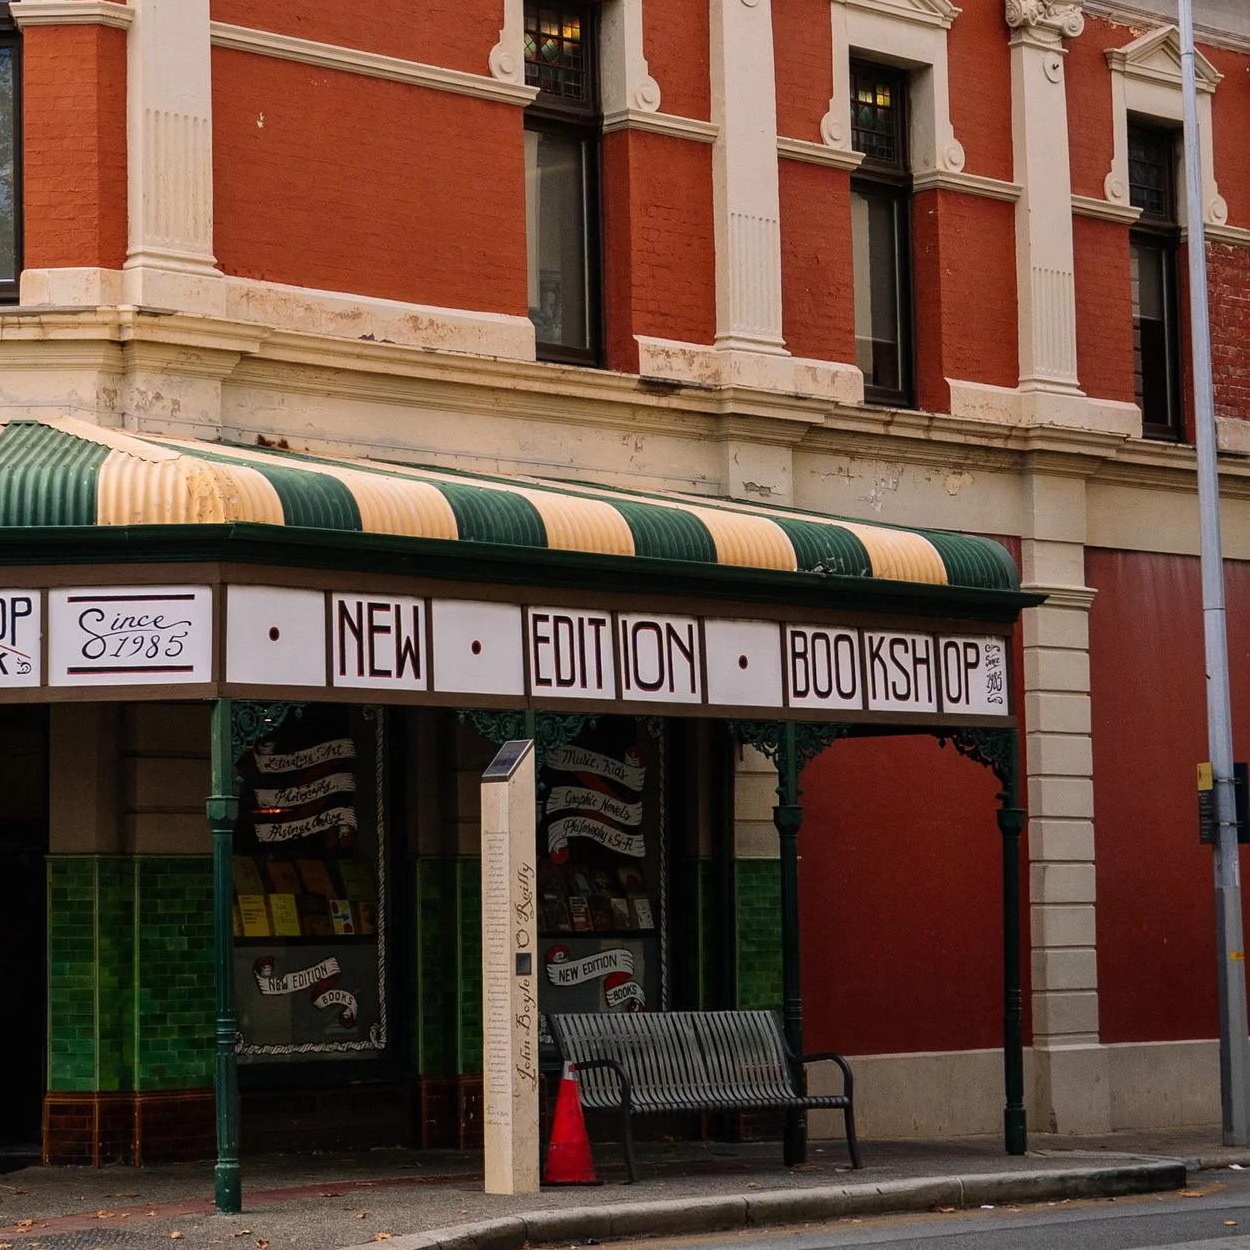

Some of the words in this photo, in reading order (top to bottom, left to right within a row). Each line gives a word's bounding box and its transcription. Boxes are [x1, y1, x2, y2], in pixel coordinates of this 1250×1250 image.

[78, 608, 191, 659] Since
[109, 632, 188, 658] 1985
[338, 600, 421, 680] NEW
[532, 613, 697, 694] EDITION
[790, 630, 980, 705] BOOKSHOP
[984, 654, 1000, 667] Since
[986, 671, 1002, 693] 1985
[317, 743, 345, 758] Art
[560, 749, 599, 770] Music,
[565, 790, 598, 809] Graphic
[599, 797, 632, 821] Novels
[562, 819, 608, 844] Philosophy
[514, 862, 535, 949] O'Reilly
[268, 976, 288, 992] NEW
[292, 963, 328, 989] EDITION
[558, 967, 579, 983] NEW
[582, 954, 618, 976] EDITION
[322, 991, 354, 1006] BOOKS
[613, 984, 638, 1001] BOOKS
[515, 979, 536, 1036] Boyle
[516, 1041, 538, 1092] John
